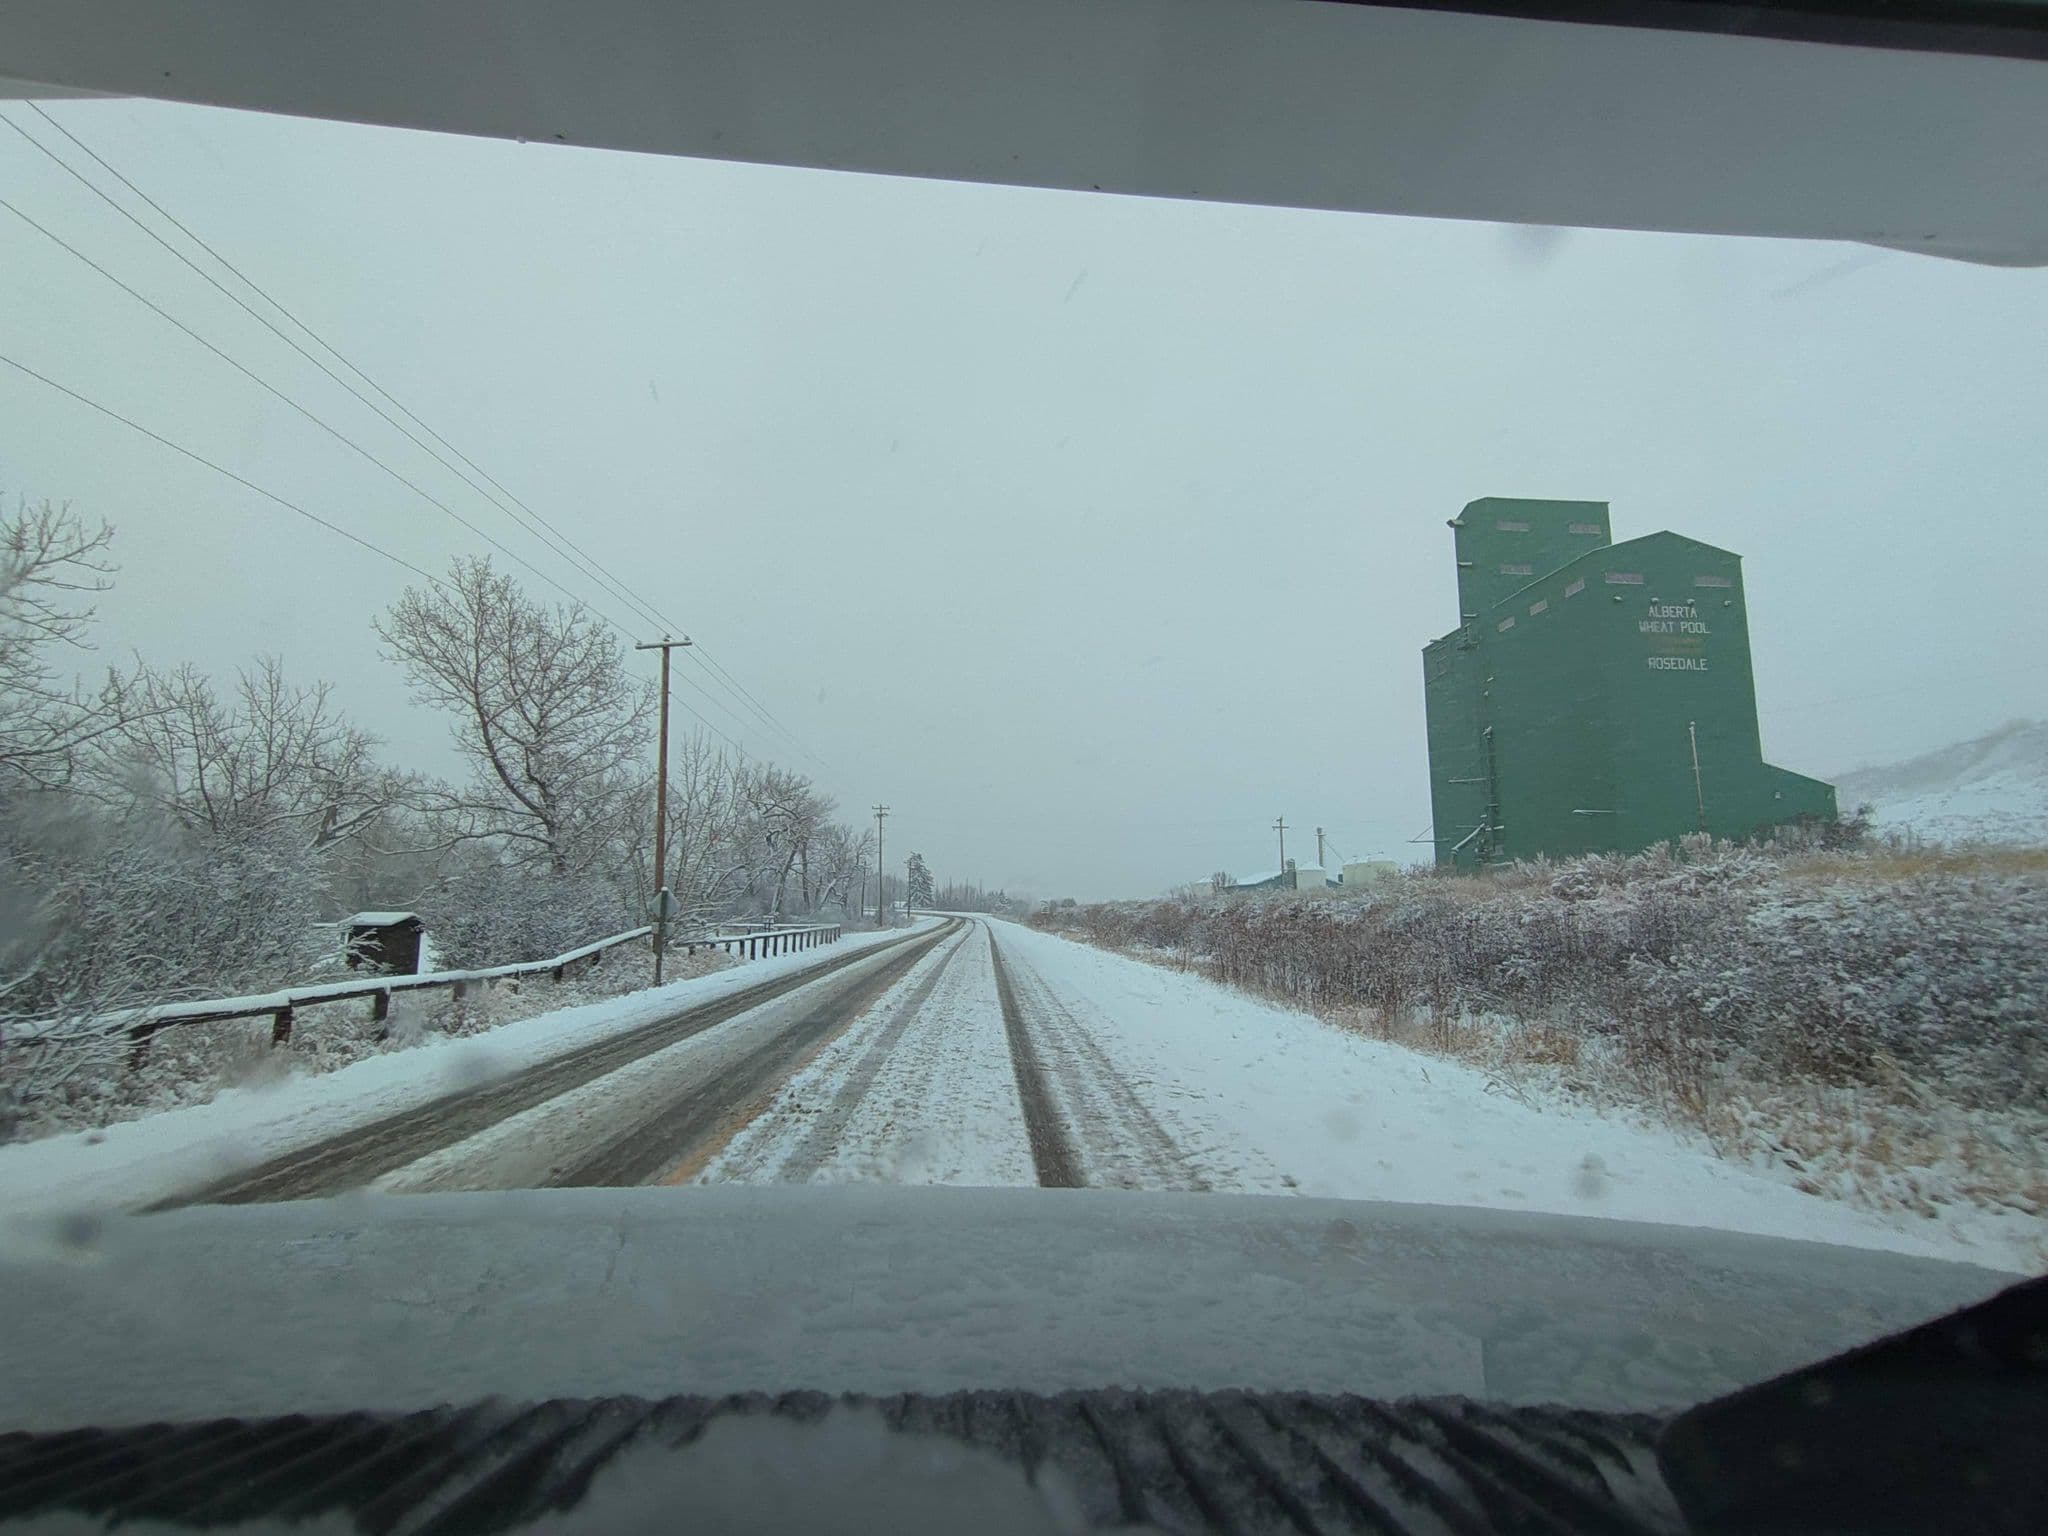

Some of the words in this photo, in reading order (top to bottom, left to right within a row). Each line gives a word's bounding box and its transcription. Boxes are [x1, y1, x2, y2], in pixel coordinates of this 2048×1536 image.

[1648, 606, 1698, 618] ALBERTA
[1639, 621, 1673, 633] WHEAT
[1680, 621, 1712, 634] POOL
[1648, 657, 1709, 671] ROSEDALE
